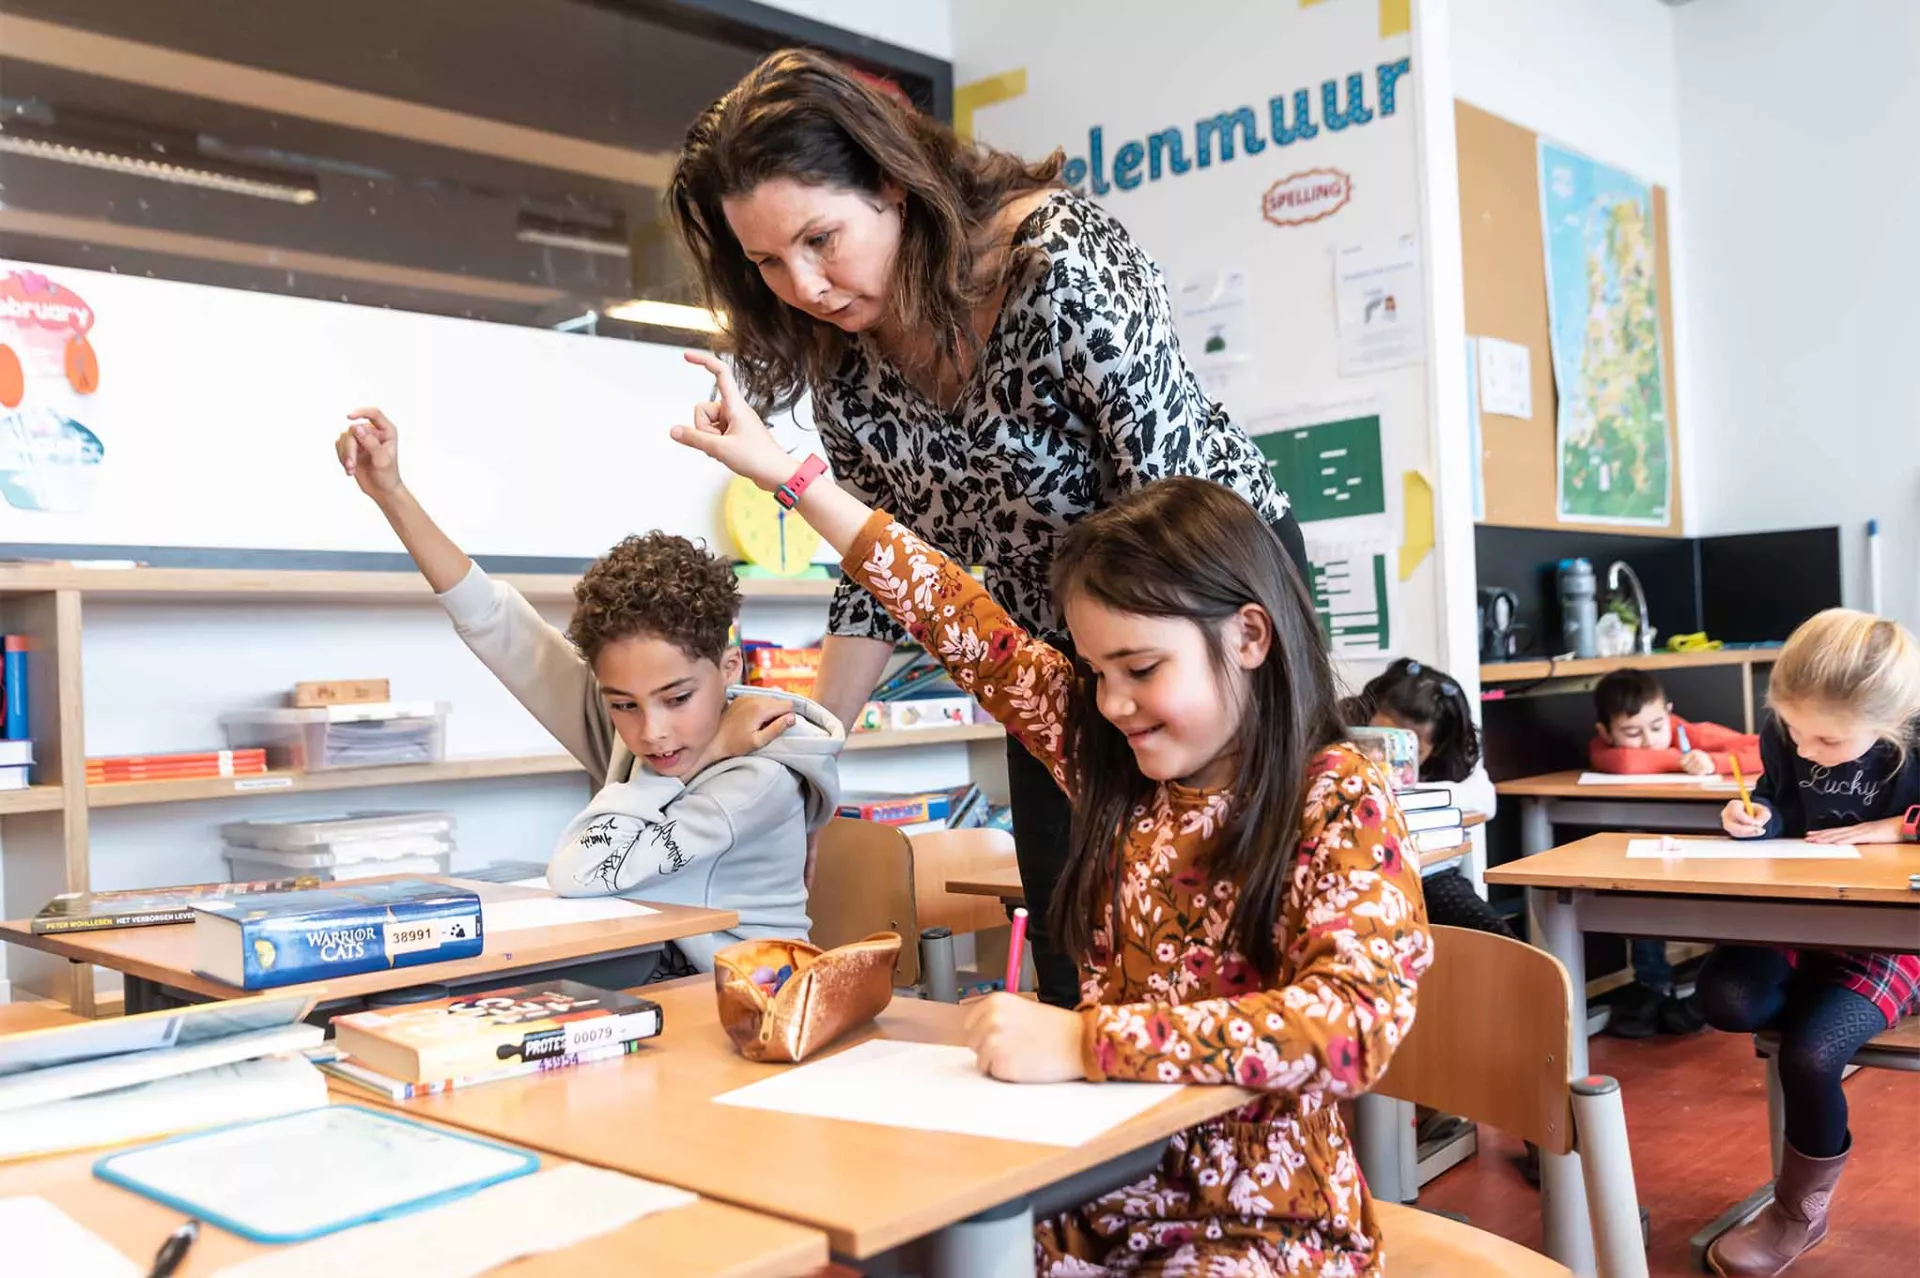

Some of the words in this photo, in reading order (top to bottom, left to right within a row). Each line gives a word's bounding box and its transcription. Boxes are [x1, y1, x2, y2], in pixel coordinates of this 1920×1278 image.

[1266, 181, 1342, 212] SPELLING
[1798, 764, 1880, 806] Lucky
[45, 919, 69, 930] PETER
[116, 915, 131, 925] HET
[132, 913, 174, 924] VERBORGEN
[306, 926, 376, 948] WARRIOR
[392, 928, 432, 944] 38991
[320, 941, 365, 963] CATS
[573, 1026, 613, 1045] 00079
